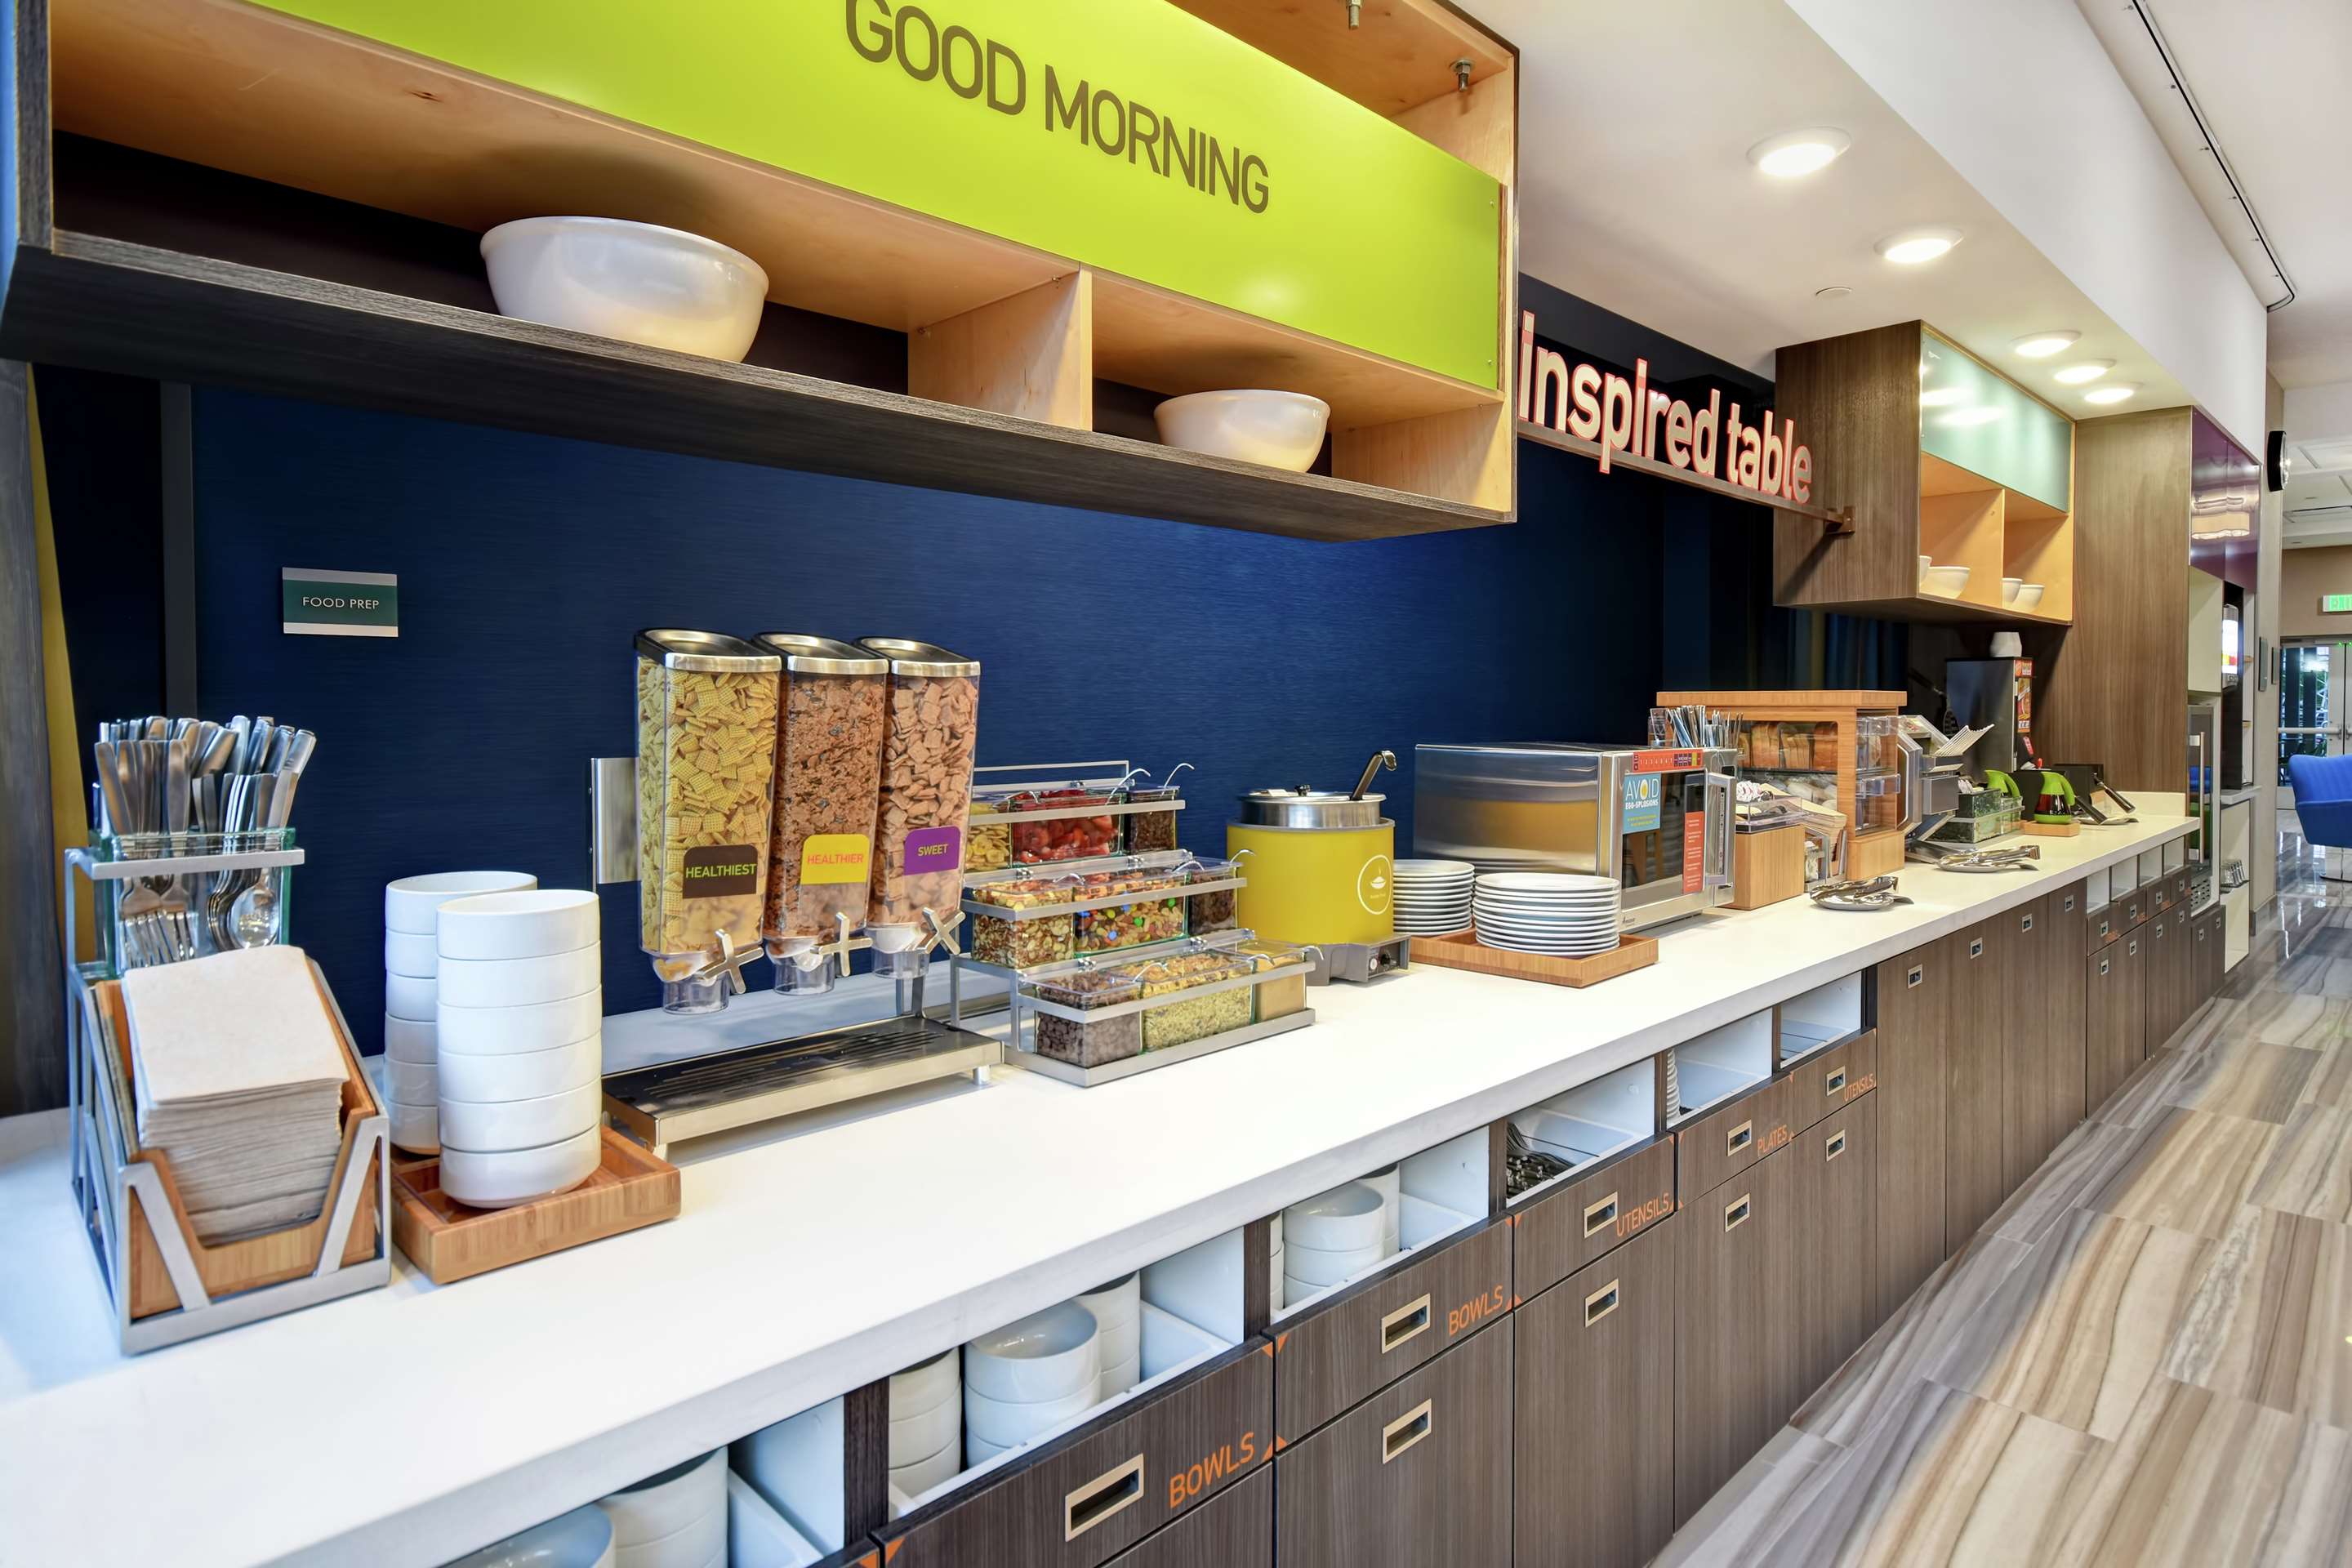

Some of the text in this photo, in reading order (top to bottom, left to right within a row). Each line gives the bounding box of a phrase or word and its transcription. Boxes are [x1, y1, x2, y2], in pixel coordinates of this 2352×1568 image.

[846, 0, 1269, 214] GOOD MORNING
[1517, 310, 1812, 504] inspired table
[302, 596, 380, 610] FOOD PREP
[1625, 779, 1659, 801] AVOID
[806, 852, 864, 865] HEALTHIER
[917, 843, 949, 857] SWEET
[685, 862, 758, 880] HEALTHIEST
[1757, 1125, 1787, 1157] PLATES
[1616, 1192, 1669, 1237] UTENSILS
[1448, 1285, 1503, 1338] BOWLS
[1169, 1432, 1255, 1509] BOWLS
